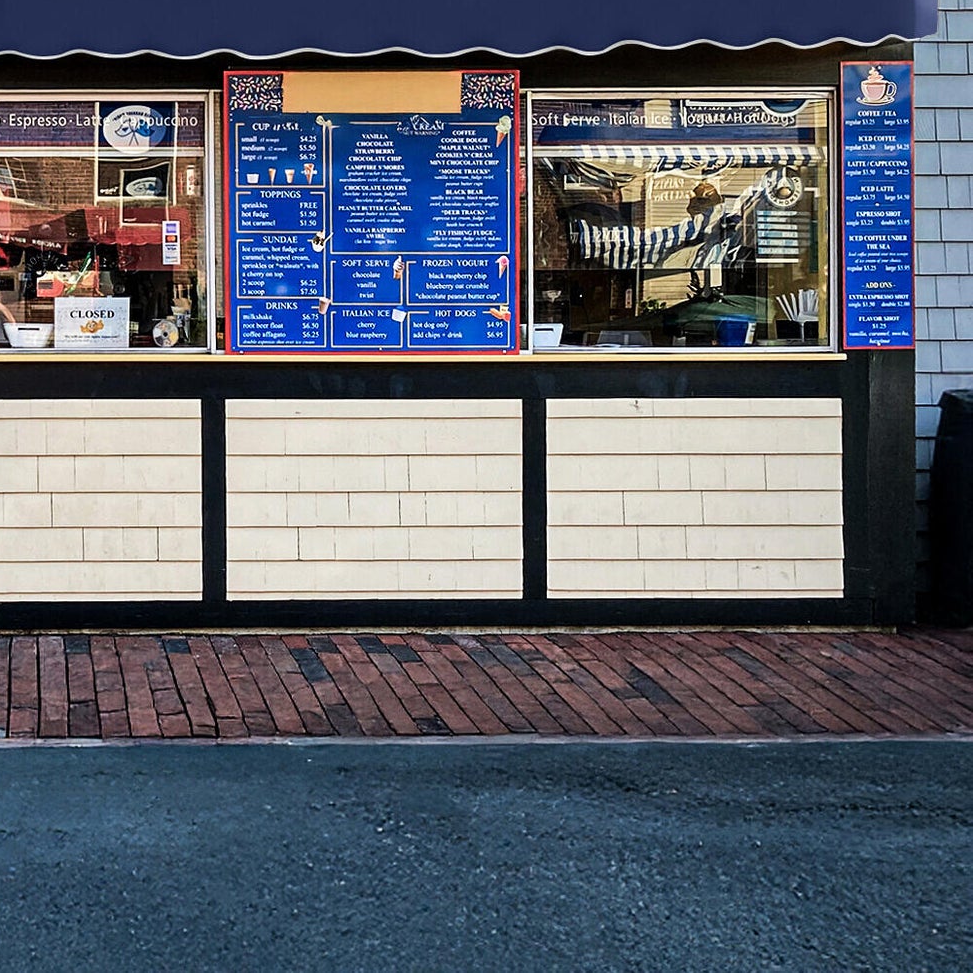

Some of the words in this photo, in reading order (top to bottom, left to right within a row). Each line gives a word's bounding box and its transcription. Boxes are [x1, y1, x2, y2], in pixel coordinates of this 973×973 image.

[10, 114, 67, 129] Espresso
[532, 113, 559, 126] Soft
[563, 113, 600, 126] Serve
[609, 112, 647, 125] Italian
[651, 112, 668, 125] Ice
[70, 310, 114, 318] CLOSED
